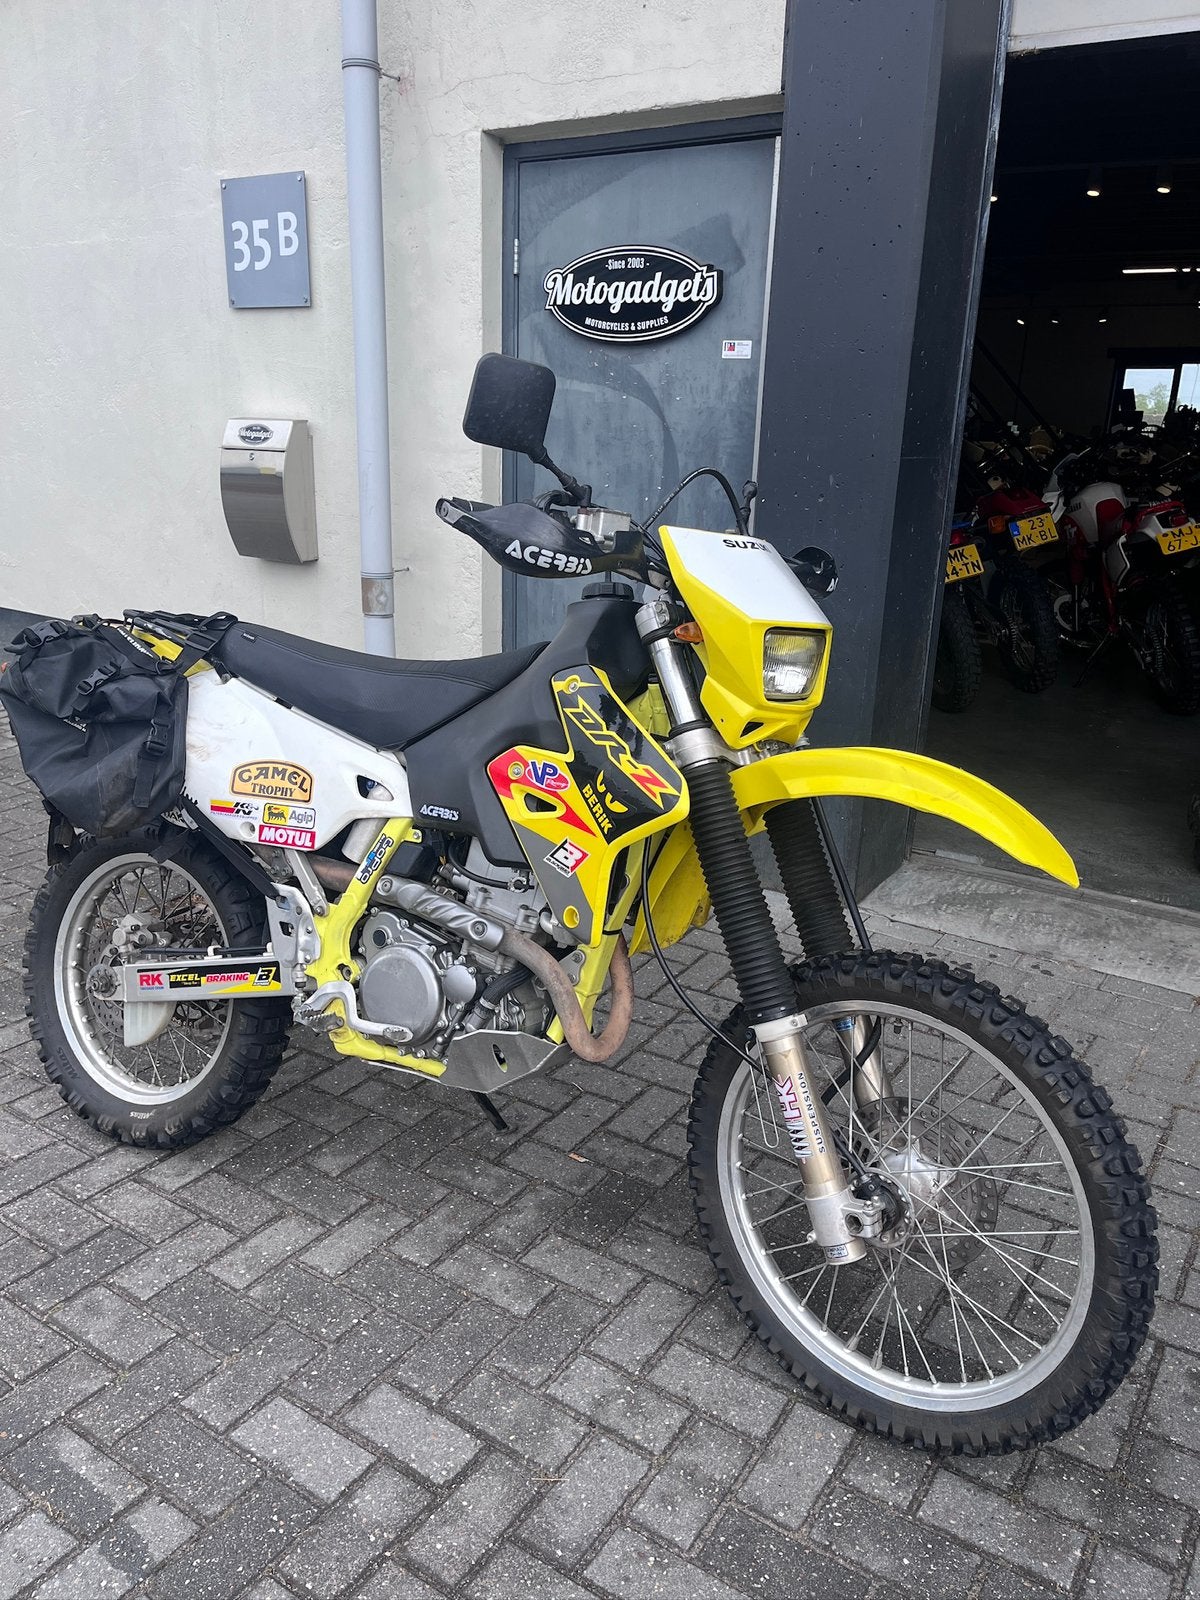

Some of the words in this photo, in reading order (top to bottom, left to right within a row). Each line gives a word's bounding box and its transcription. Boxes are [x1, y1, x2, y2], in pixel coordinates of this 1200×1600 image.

[231, 219, 272, 271] 35
[277, 211, 299, 256] B
[627, 257, 645, 269] 2003
[584, 316, 630, 331] MOTORCYCLES
[630, 322, 636, 331] &
[636, 315, 669, 331] SUPPLIES
[1027, 517, 1045, 531] 23
[1171, 525, 1193, 538] MJ
[238, 766, 309, 794] CAMEL
[529, 760, 559, 786] VP
[251, 782, 297, 798] TROPHY
[288, 810, 314, 824] Agip
[261, 826, 313, 848] MOTUL
[360, 837, 395, 884] GoPro
[140, 973, 165, 987] RK
[169, 973, 201, 982] EXCEL
[206, 973, 250, 984] BRAKING
[798, 1071, 826, 1154] SUSPENSION
